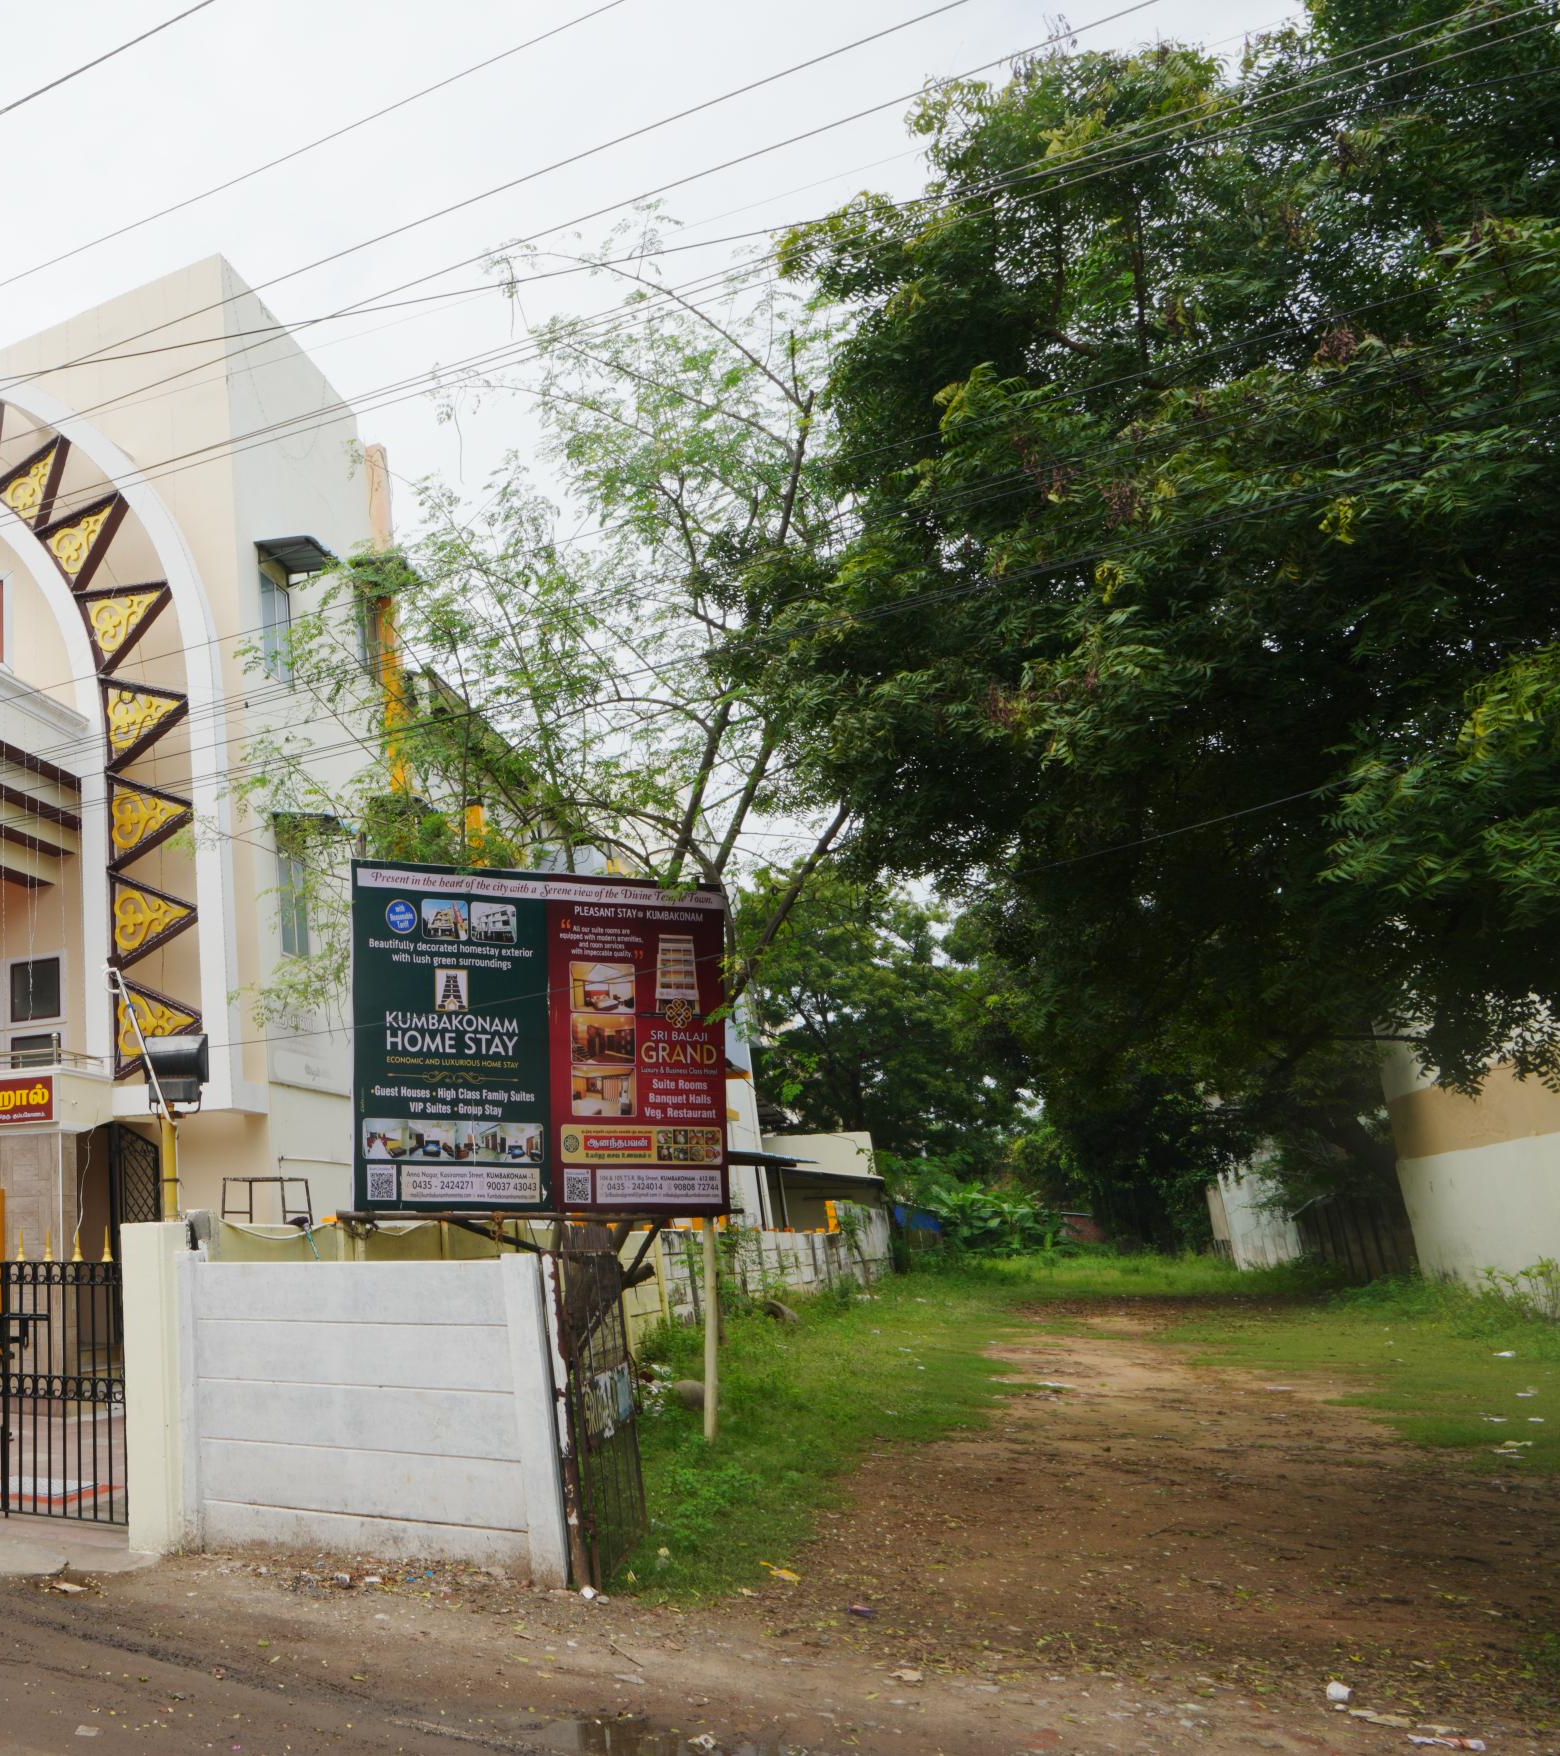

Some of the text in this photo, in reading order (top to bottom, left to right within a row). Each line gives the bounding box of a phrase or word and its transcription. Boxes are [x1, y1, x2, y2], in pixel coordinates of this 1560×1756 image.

[371, 871, 410, 884] Present
[411, 876, 420, 885] in
[422, 876, 436, 886] the
[476, 880, 490, 891] the
[492, 882, 508, 895] city
[540, 884, 572, 898] Serene
[606, 888, 619, 899] the
[621, 888, 652, 900] Divine
[574, 906, 615, 917] PLEASANT
[646, 910, 704, 922] KUMBAKONAM
[368, 938, 533, 958] Beautifully decorated homestay exterior
[392, 952, 512, 970] with lush green surroundings
[386, 1010, 519, 1034] KUMBAKONAM
[386, 1030, 519, 1056] HOME STAY
[650, 1030, 708, 1042] SRI BALAJI
[641, 1042, 717, 1065] GRAND
[386, 1056, 520, 1069] ECONOMIC AND LUXURIOUS HOME STAY
[652, 1079, 708, 1090] Suite Rooms
[374, 1084, 535, 1103] Guest Houses High Class Family Suites
[648, 1093, 712, 1105] Banquet Halls
[409, 1102, 502, 1118] VIP Suites Group Stay
[644, 1107, 716, 1119] Veg. Restaurant
[412, 1180, 433, 1190] 0435
[440, 1181, 474, 1190] 2424271
[486, 1182, 510, 1191] 90037
[513, 1182, 537, 1192] 43043
[632, 1183, 663, 1191] 2424014
